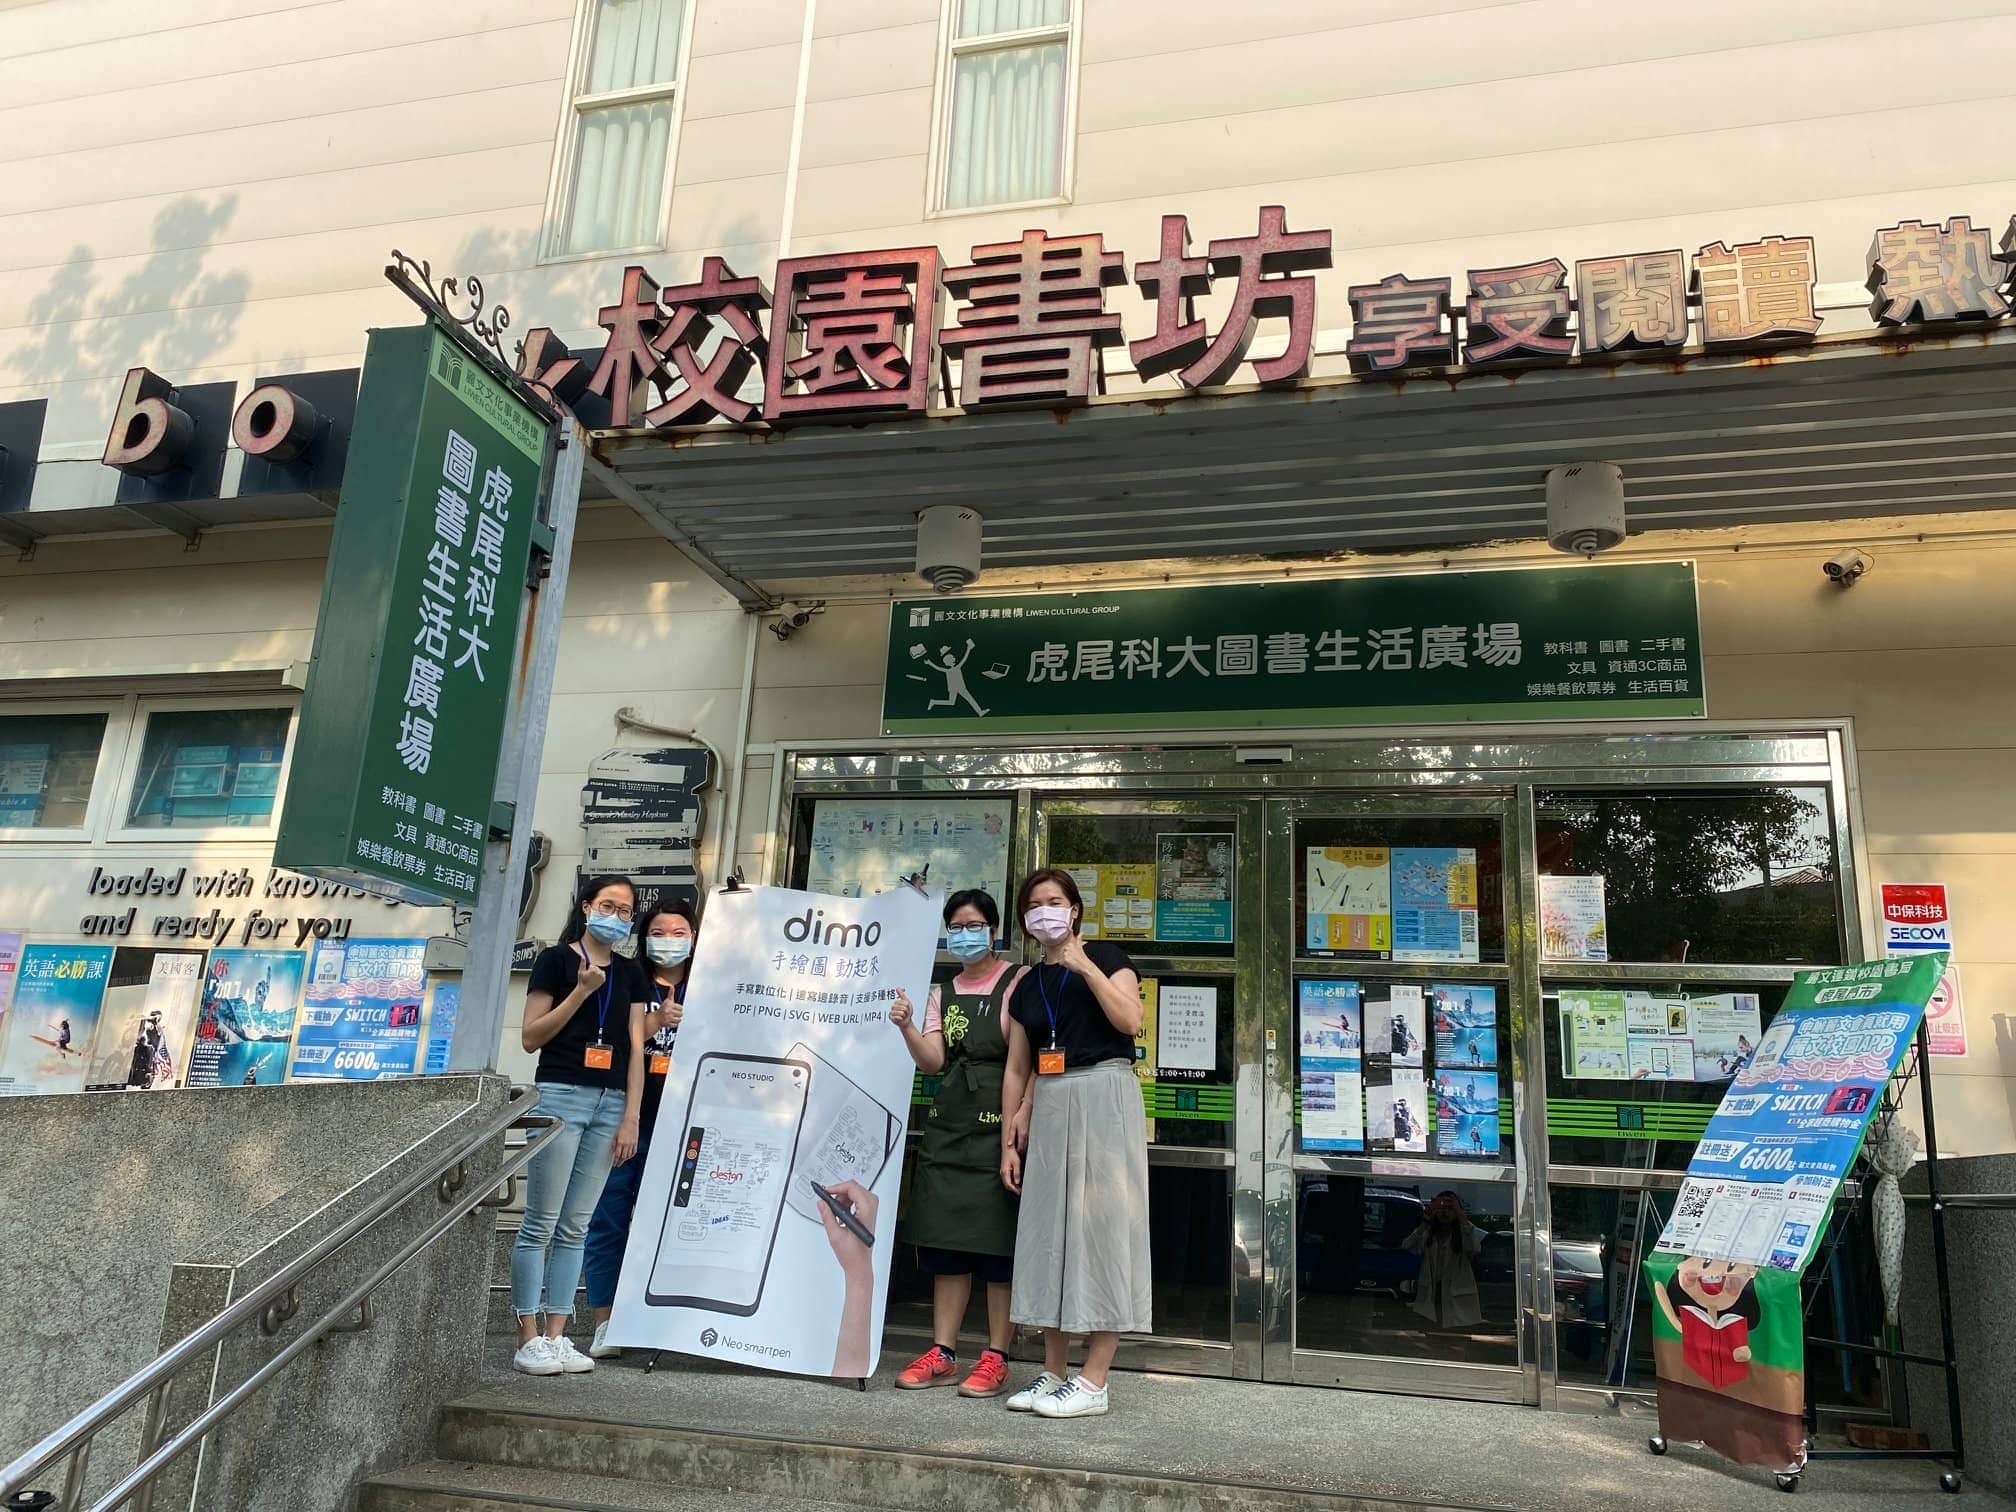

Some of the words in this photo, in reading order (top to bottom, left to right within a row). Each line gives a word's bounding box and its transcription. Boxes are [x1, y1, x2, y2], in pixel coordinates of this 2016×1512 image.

[588, 205, 1332, 428] 校園書坊
[1348, 235, 1823, 371] 享受閱讀
[1866, 213, 2016, 322] 熱
[454, 464, 513, 683] 虎尾科大
[395, 428, 478, 776] 圖書生活廣場
[1025, 608, 1050, 617] LIWEN
[1050, 607, 1091, 616] CULTURAL
[1091, 605, 1120, 614] GROUP
[1026, 621, 1523, 683] 虎尾科大圖書生活廣場
[1543, 641, 1588, 655] 教科書
[1599, 639, 1630, 653] 圖書
[1640, 637, 1686, 651] 二手書
[1567, 661, 1597, 675] 文具
[1607, 658, 1688, 674] 資通3C商品
[1527, 681, 1617, 696] 娛樂餐飲票券
[1627, 678, 1689, 694] 生活百貨
[381, 786, 417, 815] 教科書
[423, 801, 447, 826] 圖書
[451, 814, 484, 840] 二手書
[393, 821, 418, 844] 文具
[424, 831, 479, 867] 資通3C商品
[356, 837, 427, 876] 娛樂餐飲票券
[433, 863, 477, 893] 生活百貨
[87, 867, 187, 896] loaded
[192, 868, 254, 898] with
[1887, 904, 1944, 919] 中保科技
[79, 907, 138, 936] and
[151, 909, 236, 946] ready
[242, 909, 288, 946] for
[294, 918, 352, 947] you
[783, 908, 882, 948] dimo
[1889, 927, 1946, 940] SECOM
[24, 959, 105, 980] 英語必勝課
[771, 950, 828, 977] 手繪圖
[835, 955, 880, 978] 動起來
[735, 983, 787, 999] 手寫數位化
[855, 988, 899, 1005] 支援多種格
[344, 1008, 387, 1022] SWITCH
[733, 1004, 752, 1015] PDF
[758, 1005, 782, 1018] PNG
[788, 1009, 811, 1022] SVG
[818, 1012, 840, 1024] WEB
[842, 1013, 860, 1024] URL
[863, 1011, 883, 1022] MP4
[731, 1071, 747, 1081] NEO
[747, 1073, 775, 1083] STUDIO
[1769, 1094, 1828, 1112] SWITCH
[709, 1165, 743, 1185] design
[721, 1335, 743, 1351] Neo
[743, 1341, 792, 1359] smartpen
